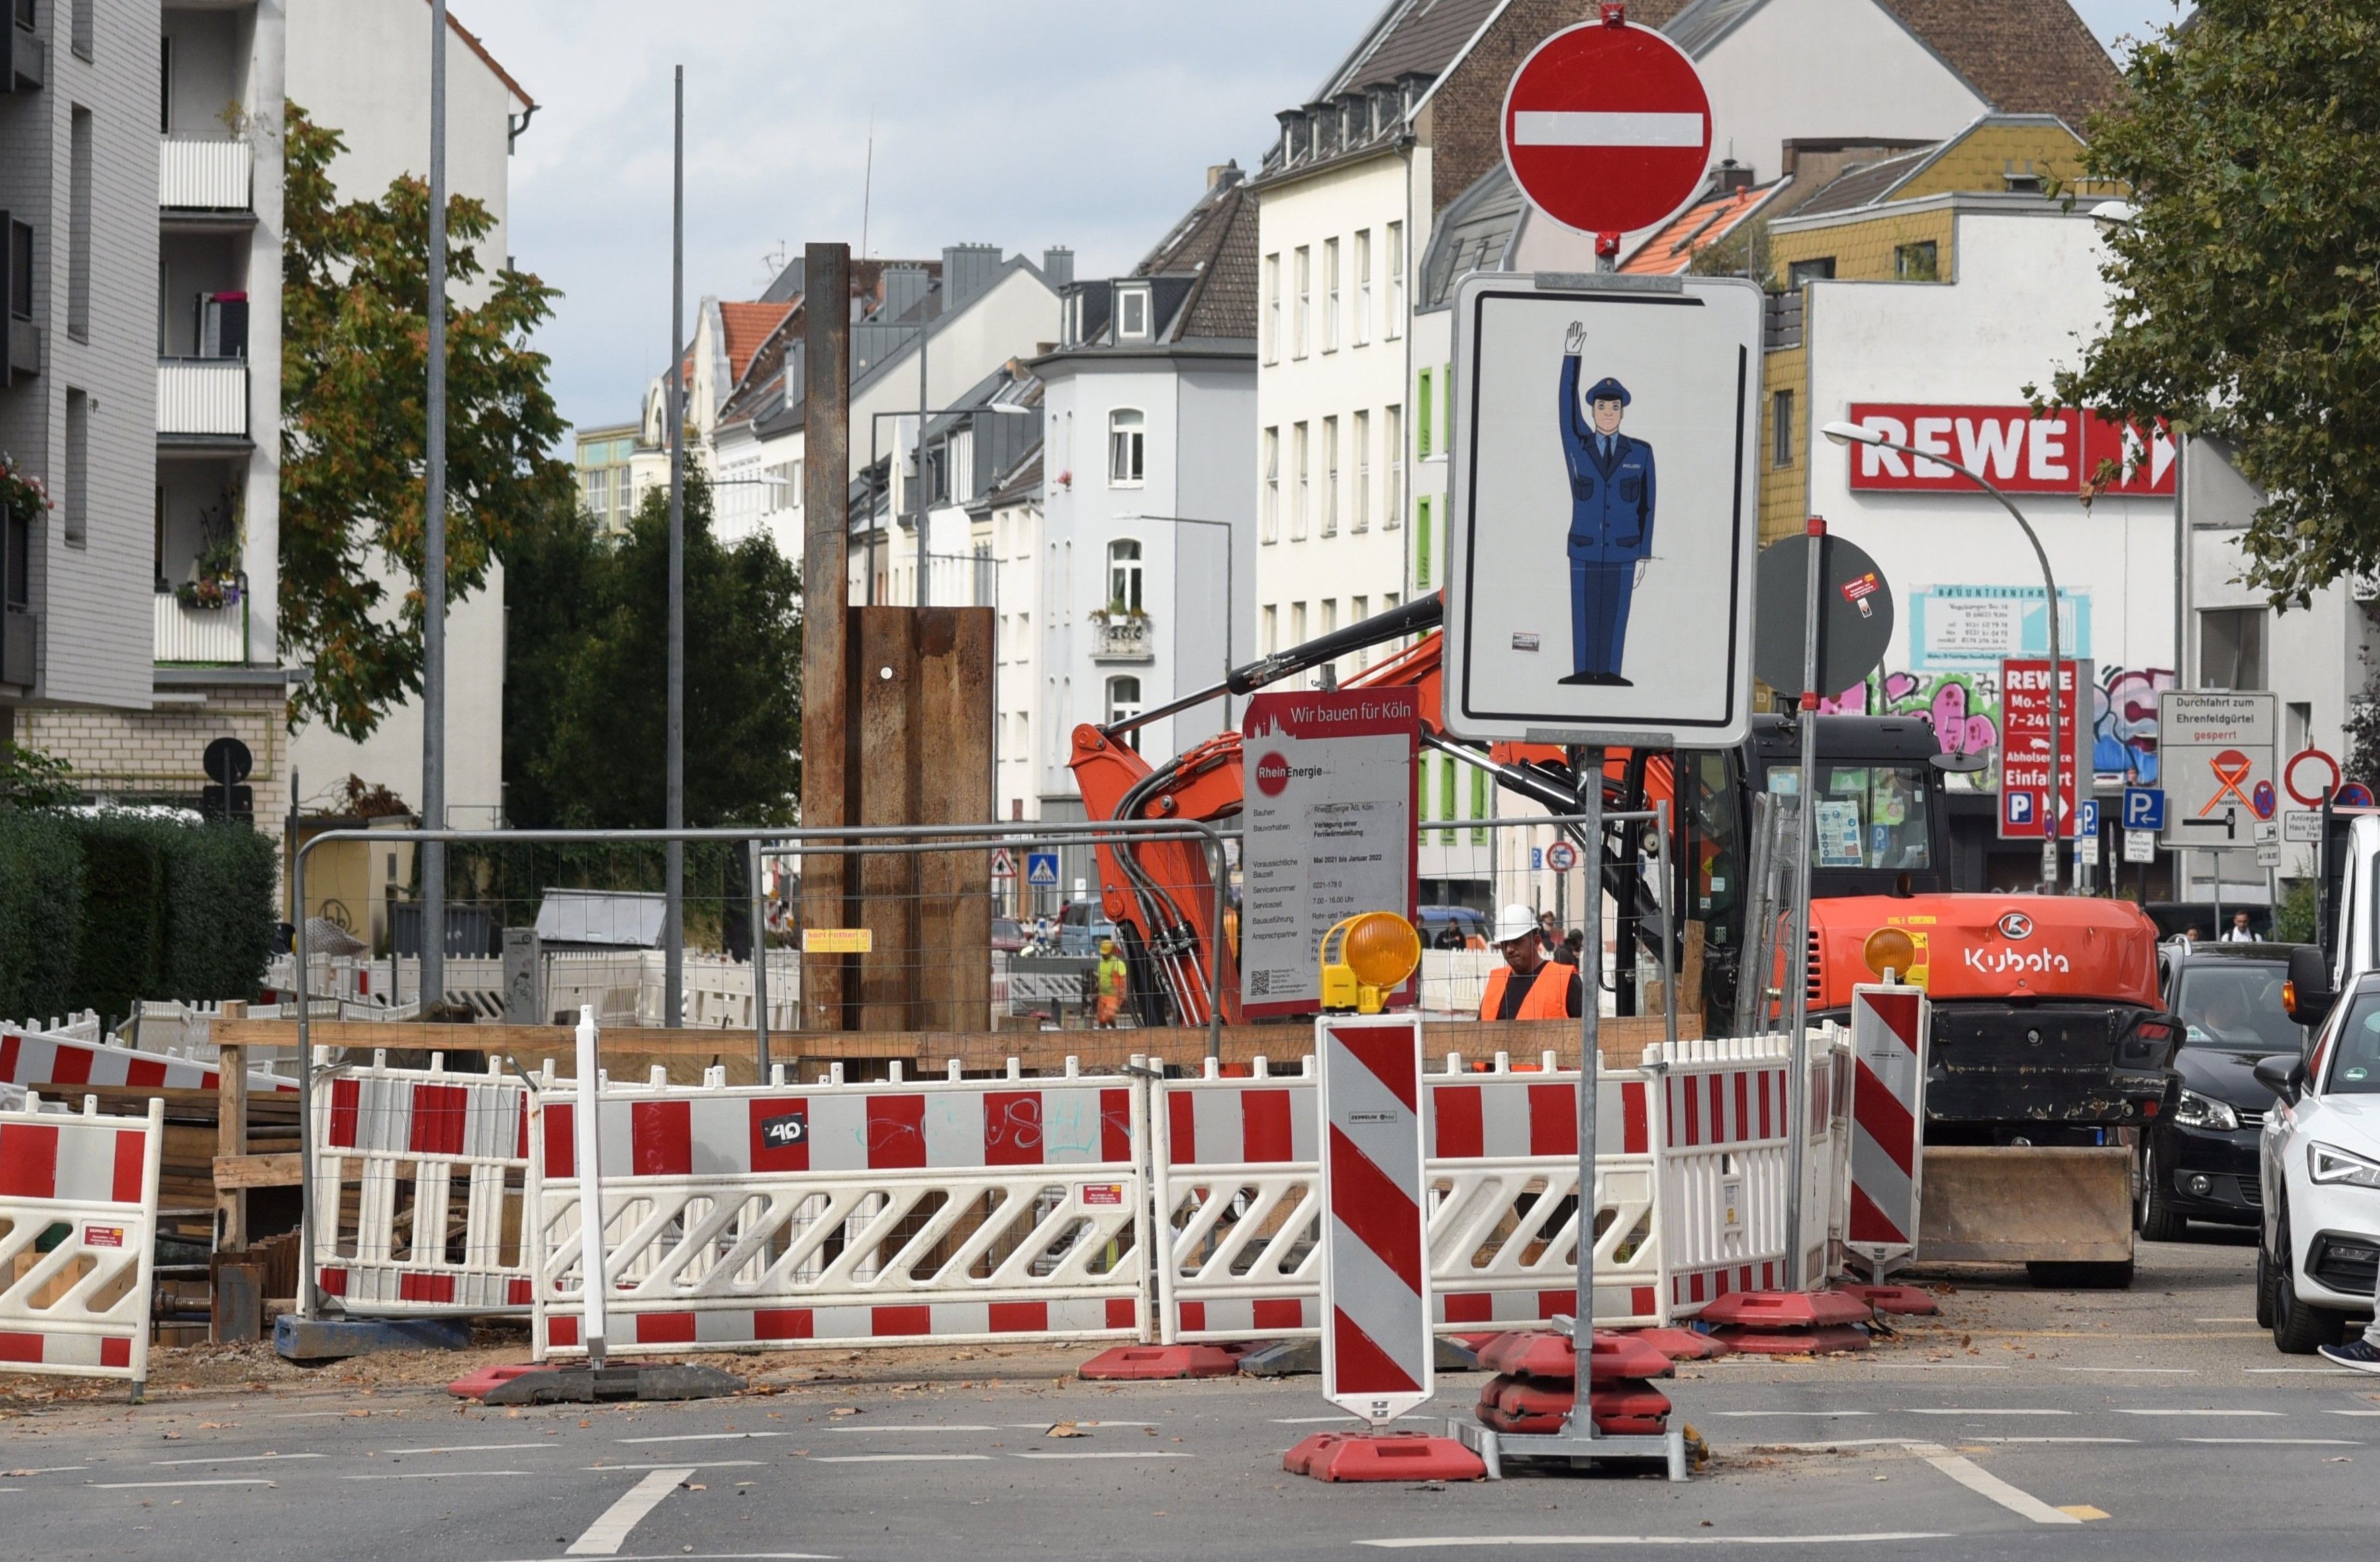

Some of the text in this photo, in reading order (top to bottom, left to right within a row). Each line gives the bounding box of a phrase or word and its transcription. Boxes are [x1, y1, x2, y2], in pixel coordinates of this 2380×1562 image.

[1861, 416, 2070, 480] REWE
[1938, 588, 2062, 598] BAUUNTERNEHMN
[2007, 671, 2073, 690] REWE
[2177, 698, 2230, 707] Durchfahrt
[1291, 700, 1411, 723] Wir bauen für Köln
[2177, 714, 2254, 725] Ehrenfeldgürtel
[2194, 731, 2237, 741] gesperrt
[1259, 765, 1323, 778] RheinEnergie
[2130, 792, 2152, 823] P
[1253, 809, 1275, 817] Bauherr
[1253, 824, 1290, 832] Bauvorhaben
[1314, 821, 1342, 829] Verlegung
[1253, 858, 1298, 868] Voraussichtliche
[1253, 870, 1274, 878] Bauzeit
[1253, 885, 1296, 894] Servicenummer
[1252, 901, 1282, 909] Servicezeit
[1252, 916, 1294, 925] Bauausführung
[1252, 931, 1298, 940] Ansprechpartner
[1964, 947, 2069, 972] Kubota
